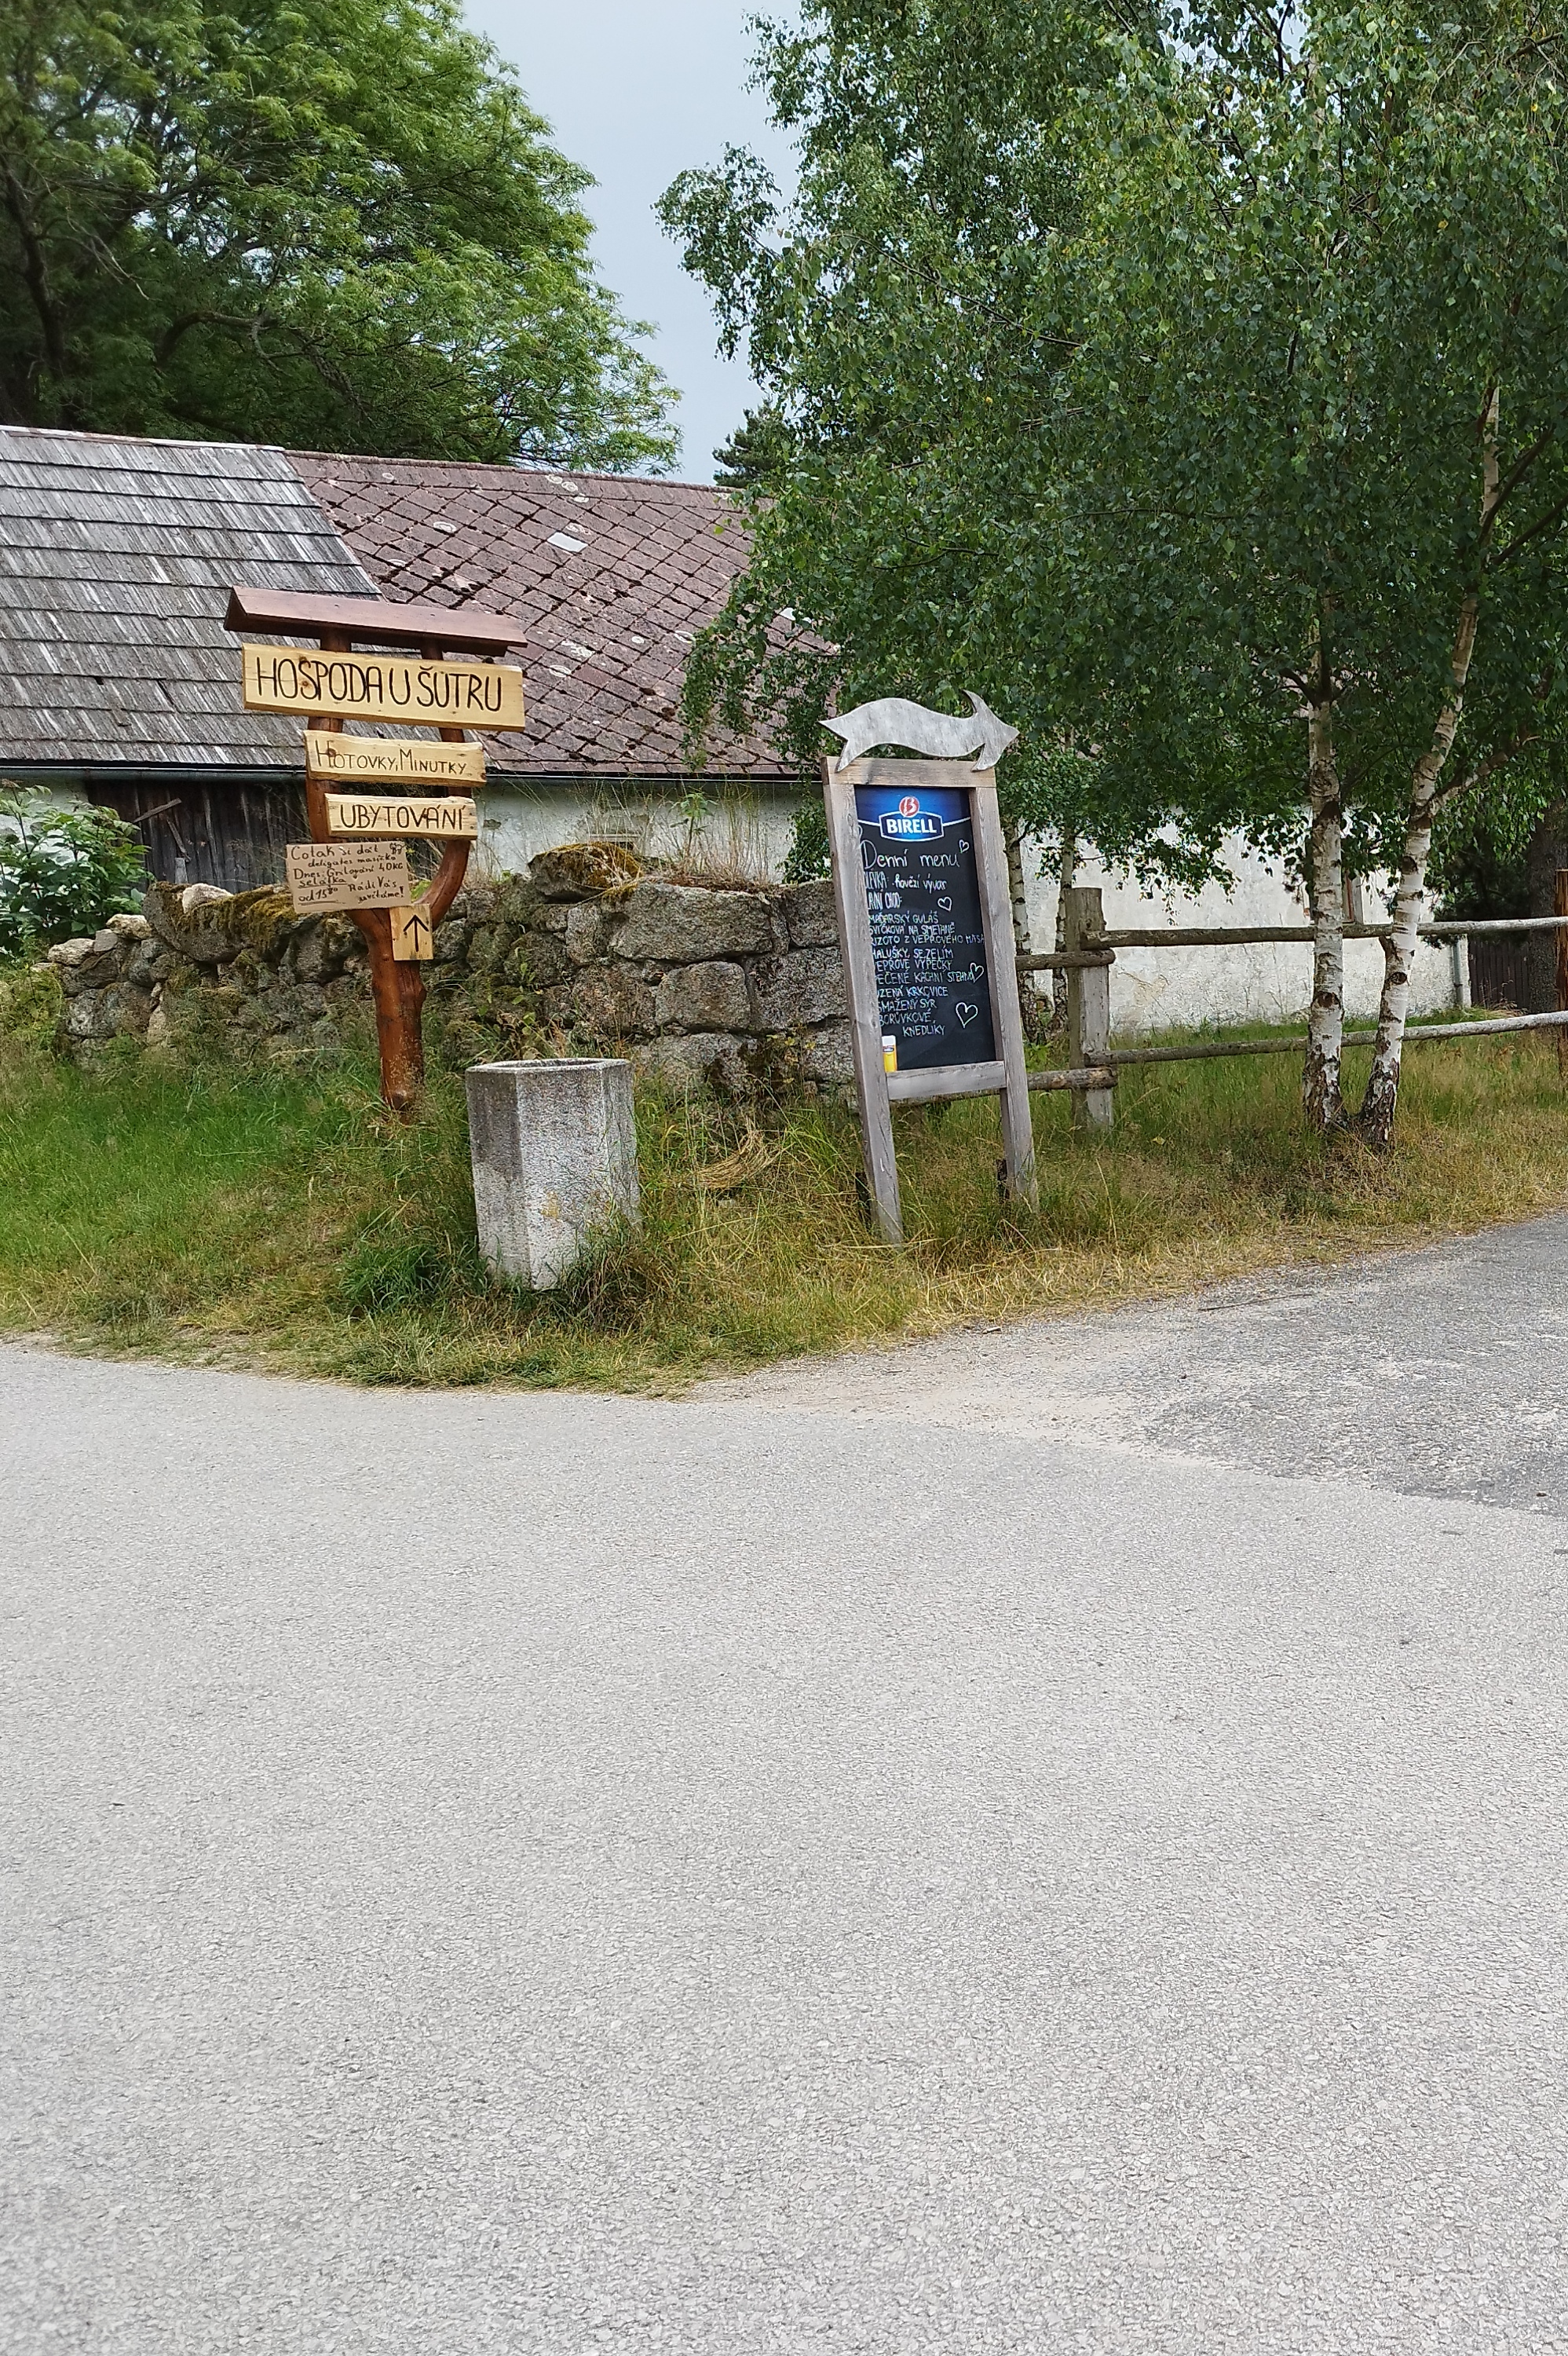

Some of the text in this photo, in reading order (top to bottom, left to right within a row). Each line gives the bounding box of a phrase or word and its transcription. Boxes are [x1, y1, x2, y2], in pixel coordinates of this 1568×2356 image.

[257, 657, 502, 712] HOSPODA U ŠUTRU
[340, 803, 466, 831] UBYTOVÁNÍ
[886, 818, 937, 834] BIRELL
[860, 840, 959, 869] Denní menu
[875, 969, 911, 985] EČENÉ
